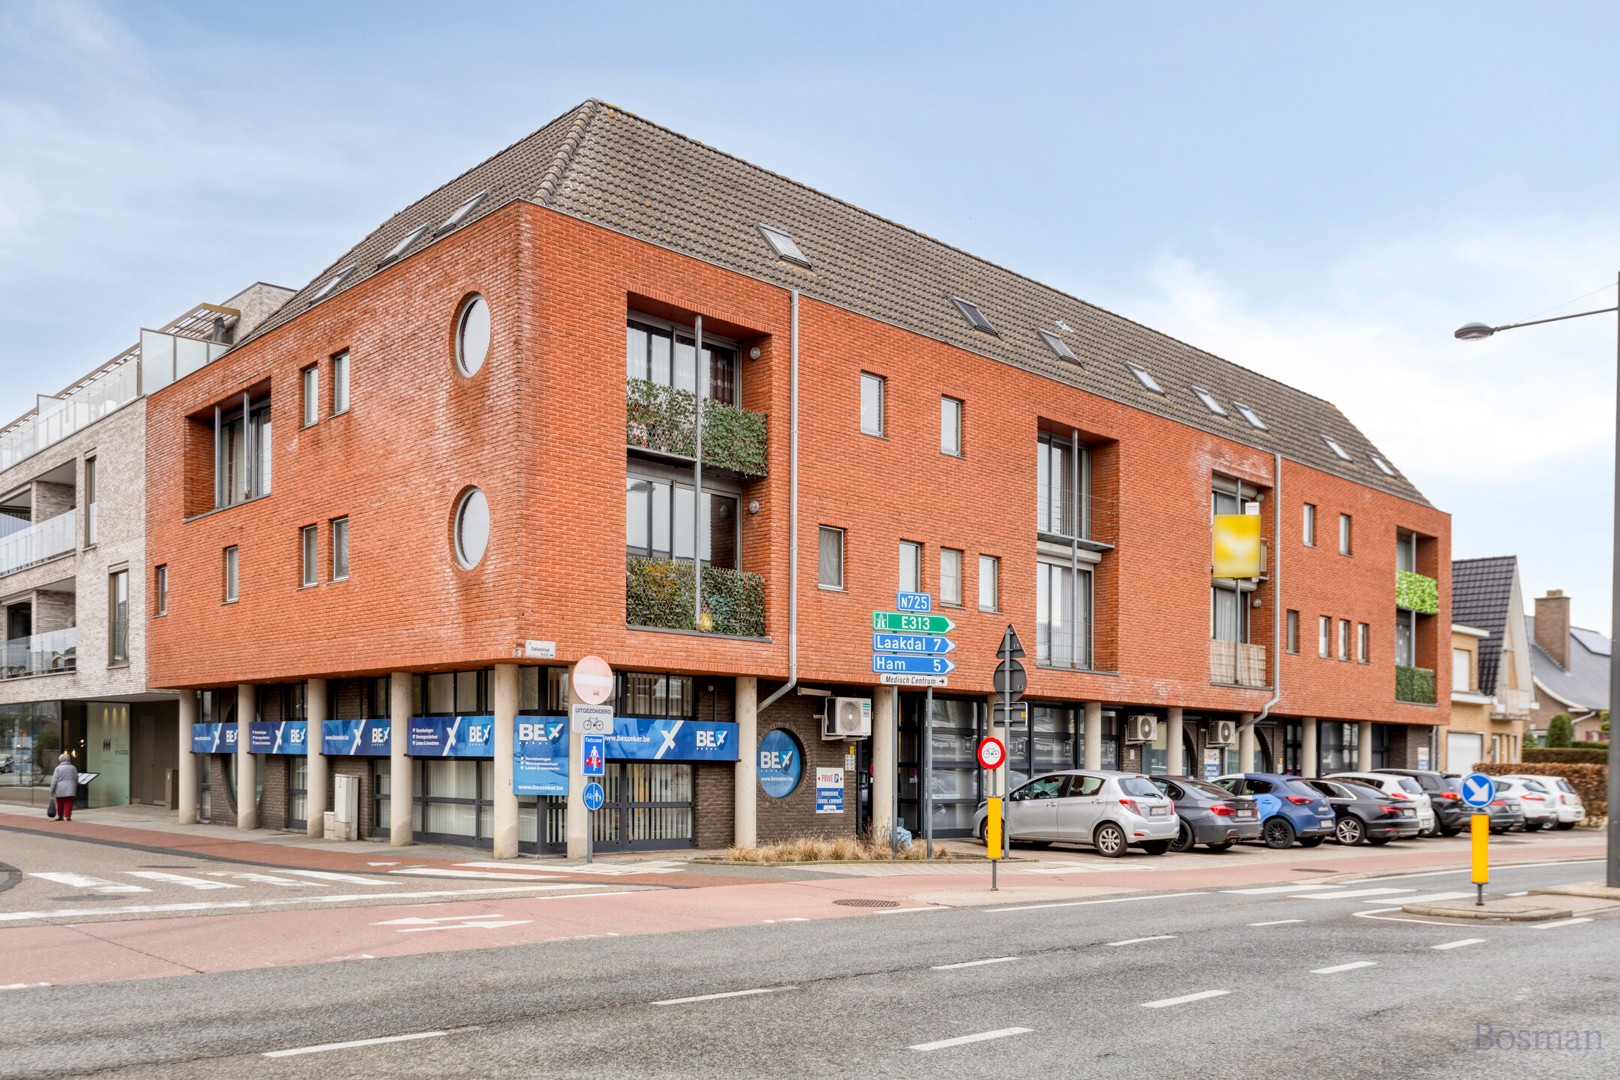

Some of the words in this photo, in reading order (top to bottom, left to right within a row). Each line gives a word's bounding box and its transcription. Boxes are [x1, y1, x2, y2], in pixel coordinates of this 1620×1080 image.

[901, 595, 928, 609] N725
[901, 616, 930, 630] E313
[877, 636, 926, 651] Laakdal
[933, 639, 942, 651] 7
[876, 656, 906, 670] Ham
[933, 659, 941, 672] 5
[886, 675, 910, 684] Medisch
[911, 677, 936, 685] Centrum
[575, 707, 612, 715] UITGEZONDERD
